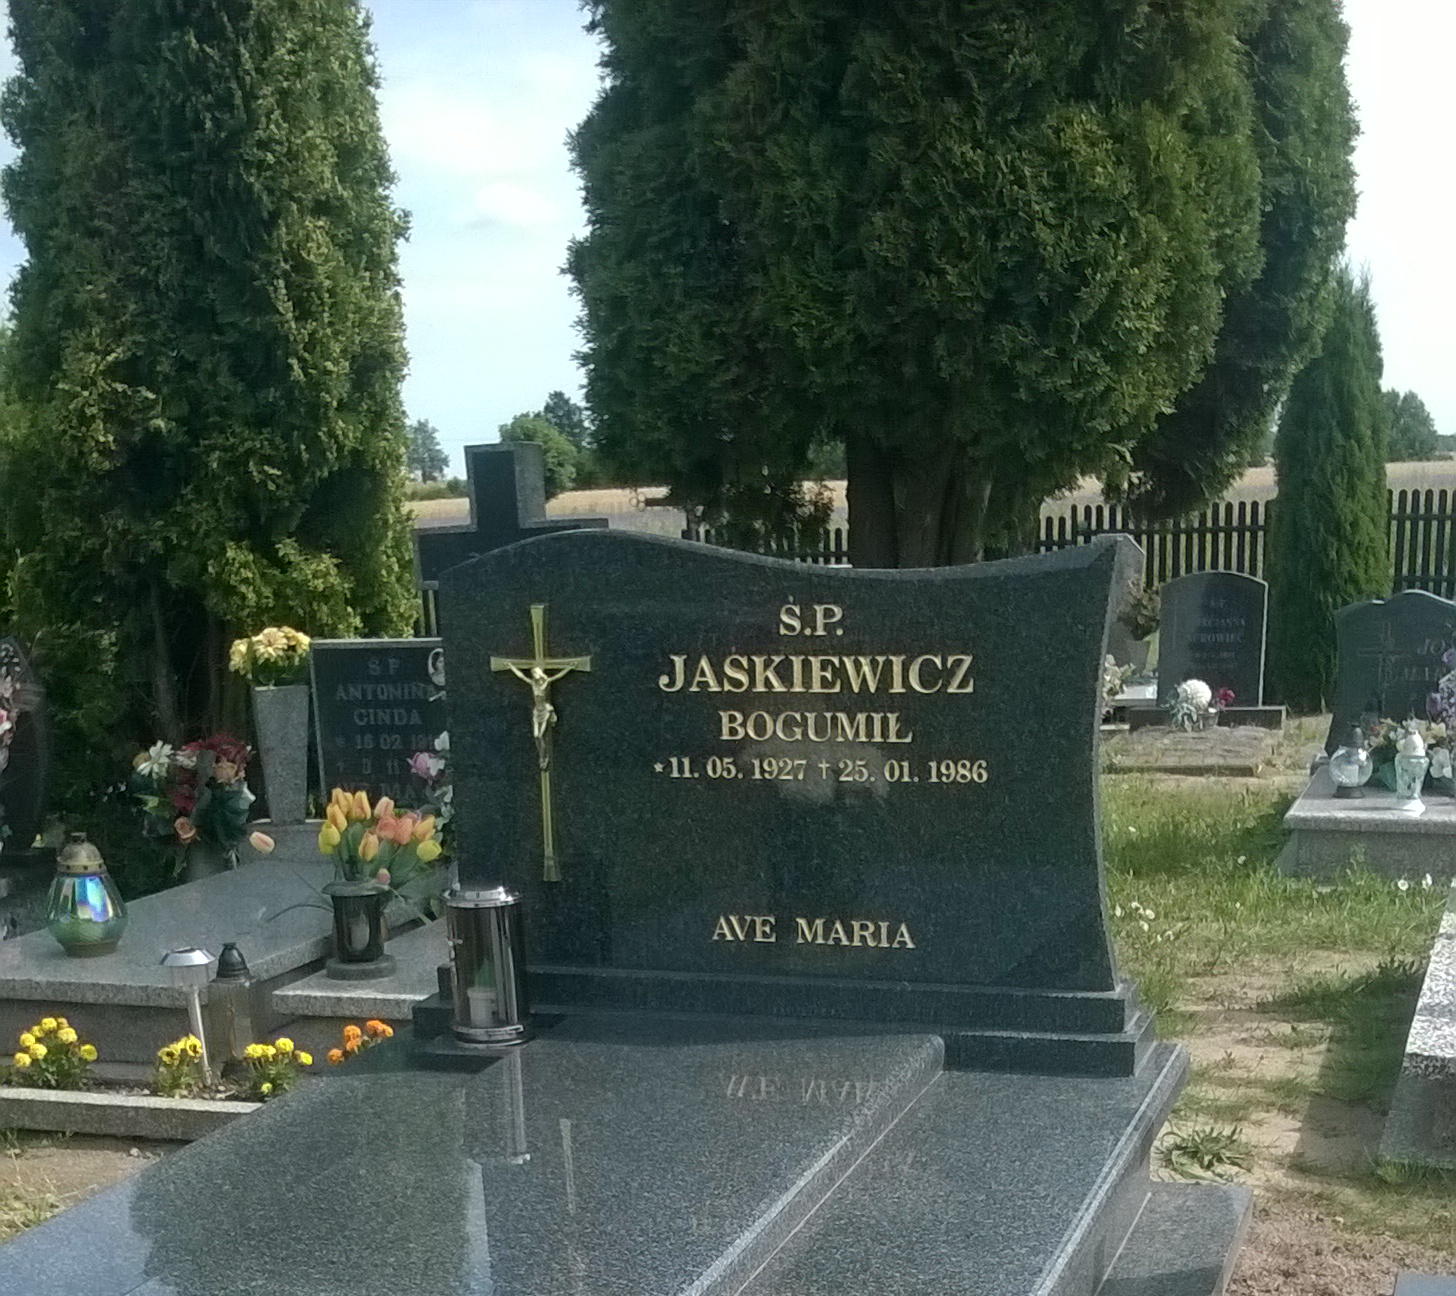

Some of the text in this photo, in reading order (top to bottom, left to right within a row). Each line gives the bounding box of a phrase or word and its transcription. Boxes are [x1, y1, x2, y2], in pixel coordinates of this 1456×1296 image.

[718, 710, 914, 743] BOGUMIŁ
[751, 757, 808, 781] 1927
[927, 759, 989, 784] 1986
[712, 914, 917, 949] AVE MARIA
